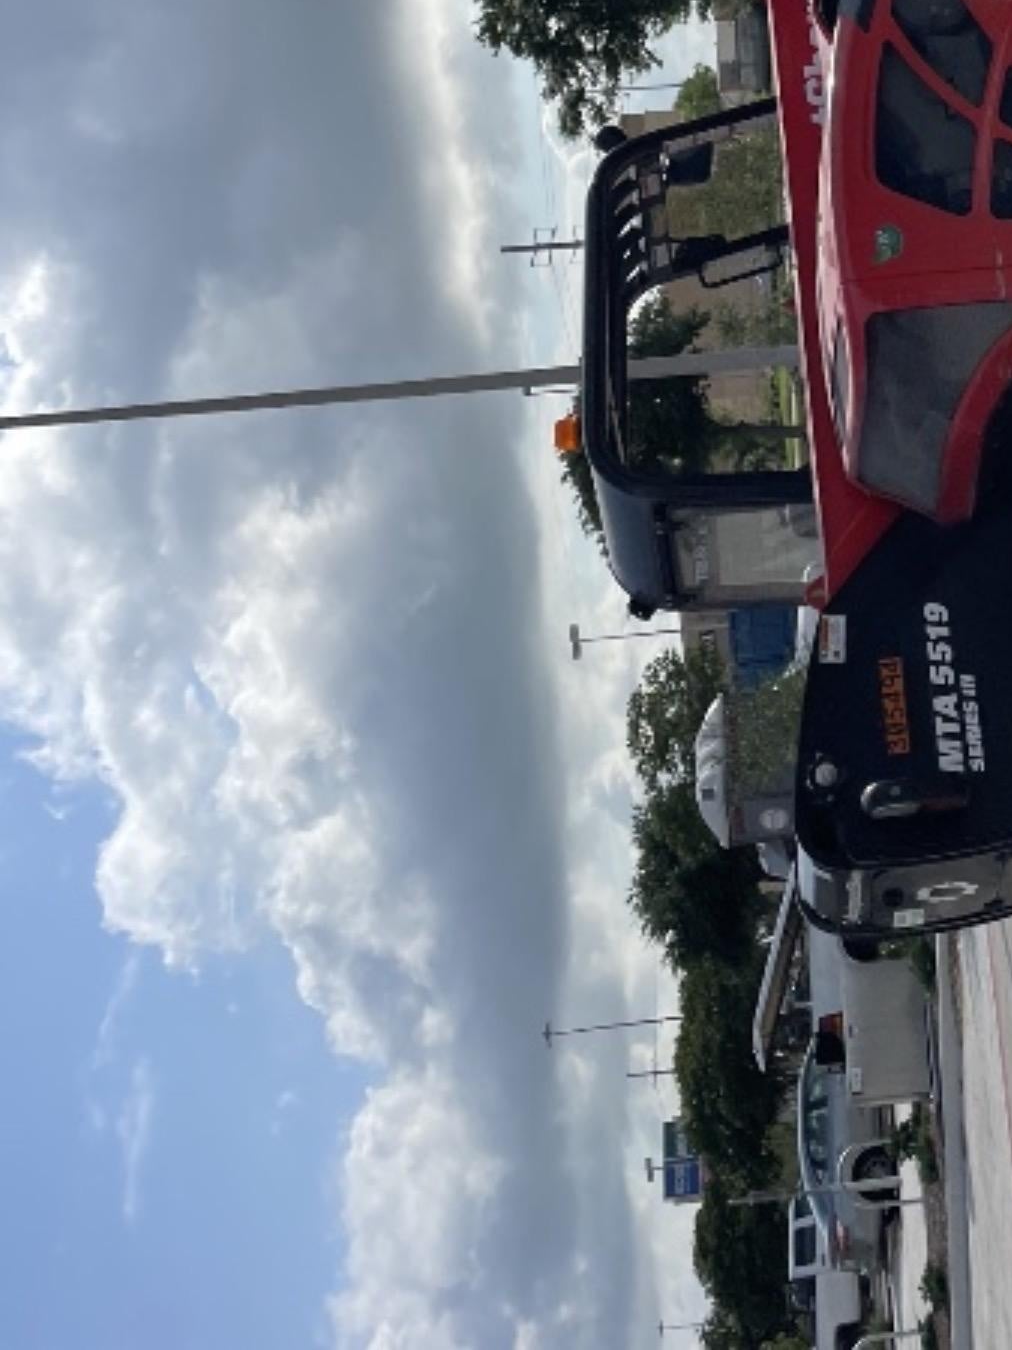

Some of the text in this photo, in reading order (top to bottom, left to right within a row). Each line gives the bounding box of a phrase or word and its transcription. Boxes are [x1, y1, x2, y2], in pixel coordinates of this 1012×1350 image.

[923, 602, 964, 772] MTA 5519
[962, 701, 985, 772] SERIES
